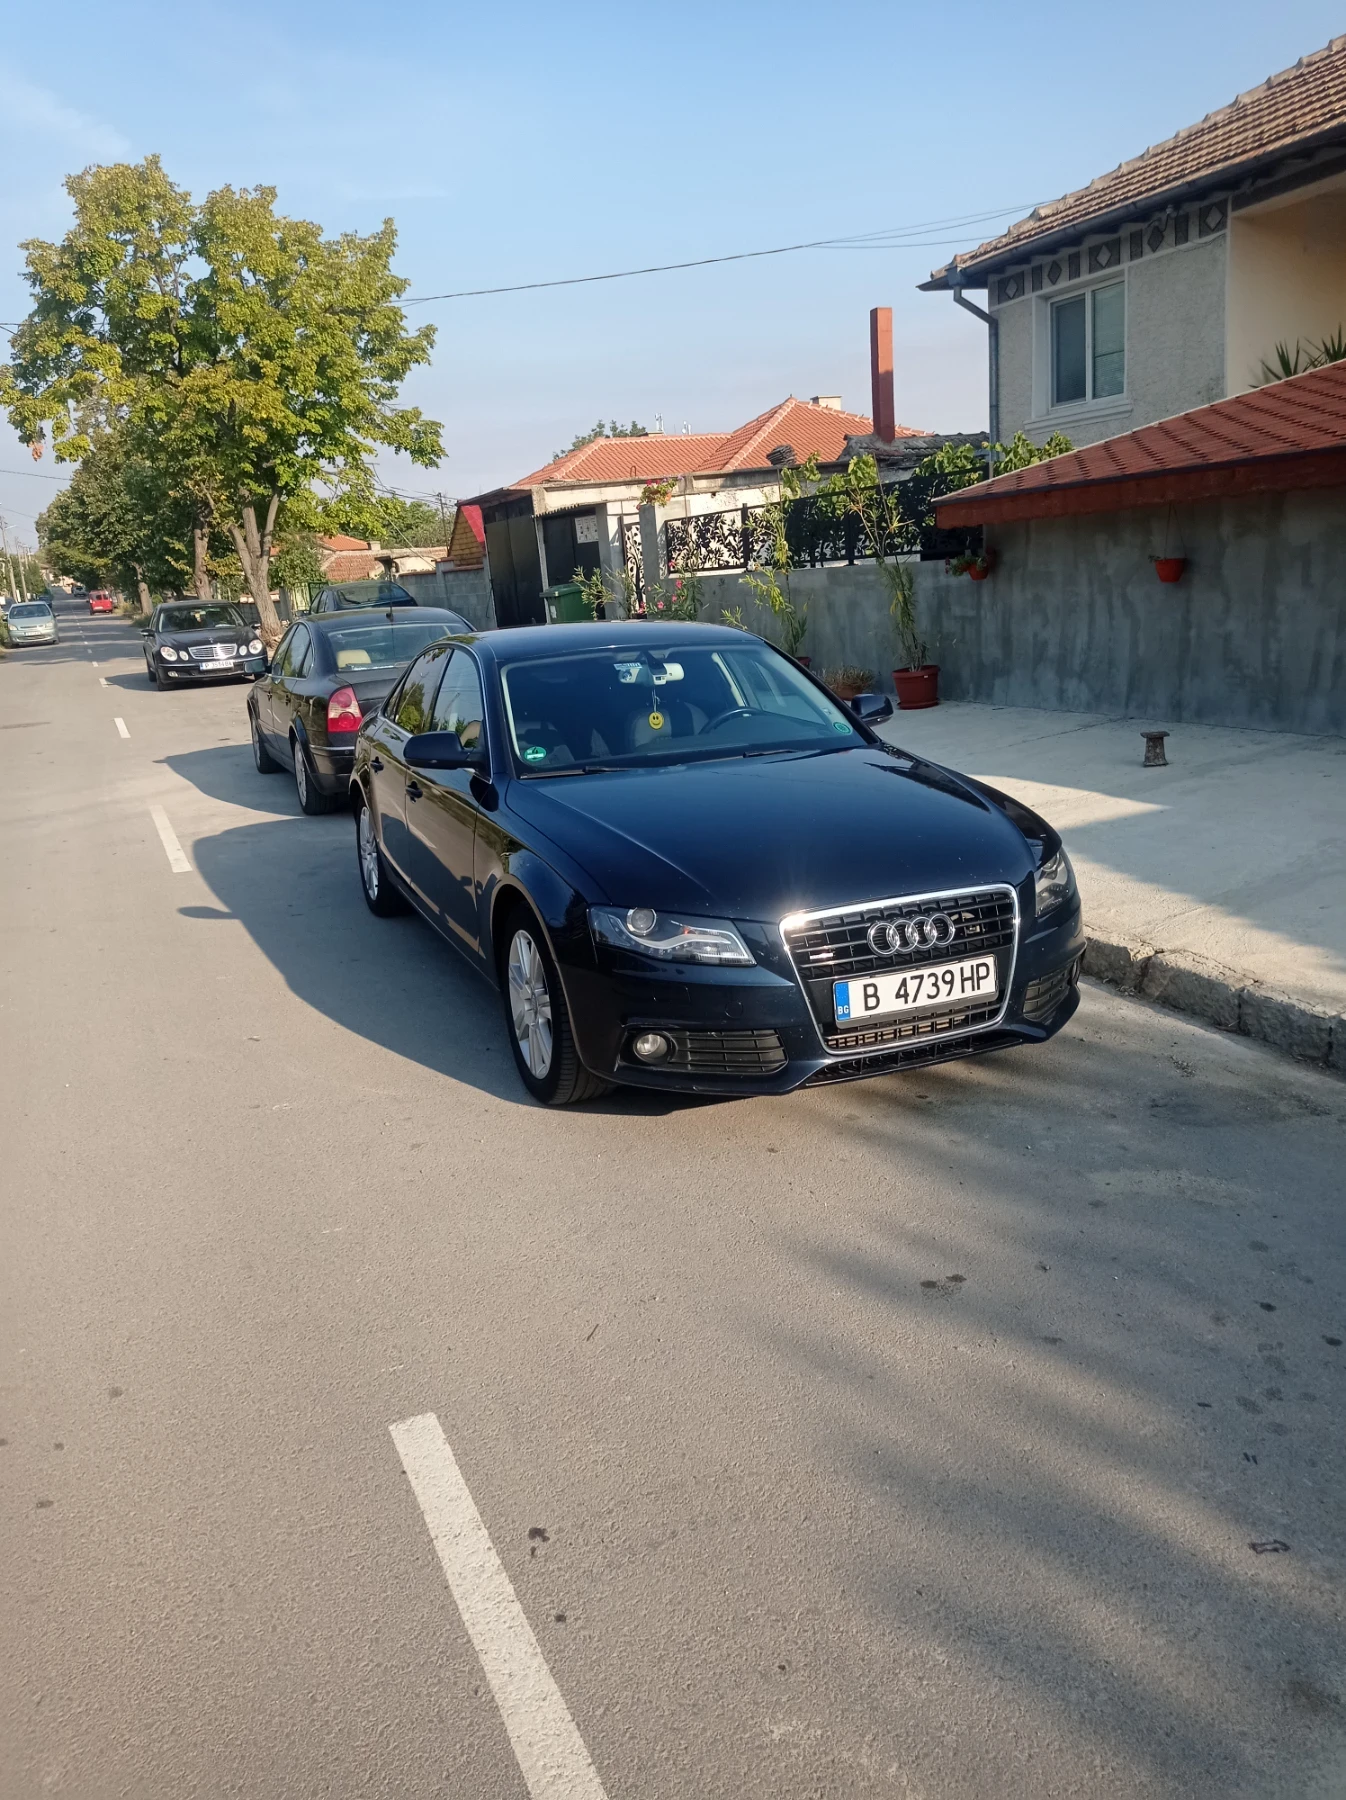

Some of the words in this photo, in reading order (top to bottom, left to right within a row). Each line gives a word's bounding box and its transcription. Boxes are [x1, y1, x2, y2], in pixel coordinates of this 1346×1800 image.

[863, 983, 880, 1011] B
[895, 969, 955, 1004] 4739
[837, 1005, 849, 1015] BG
